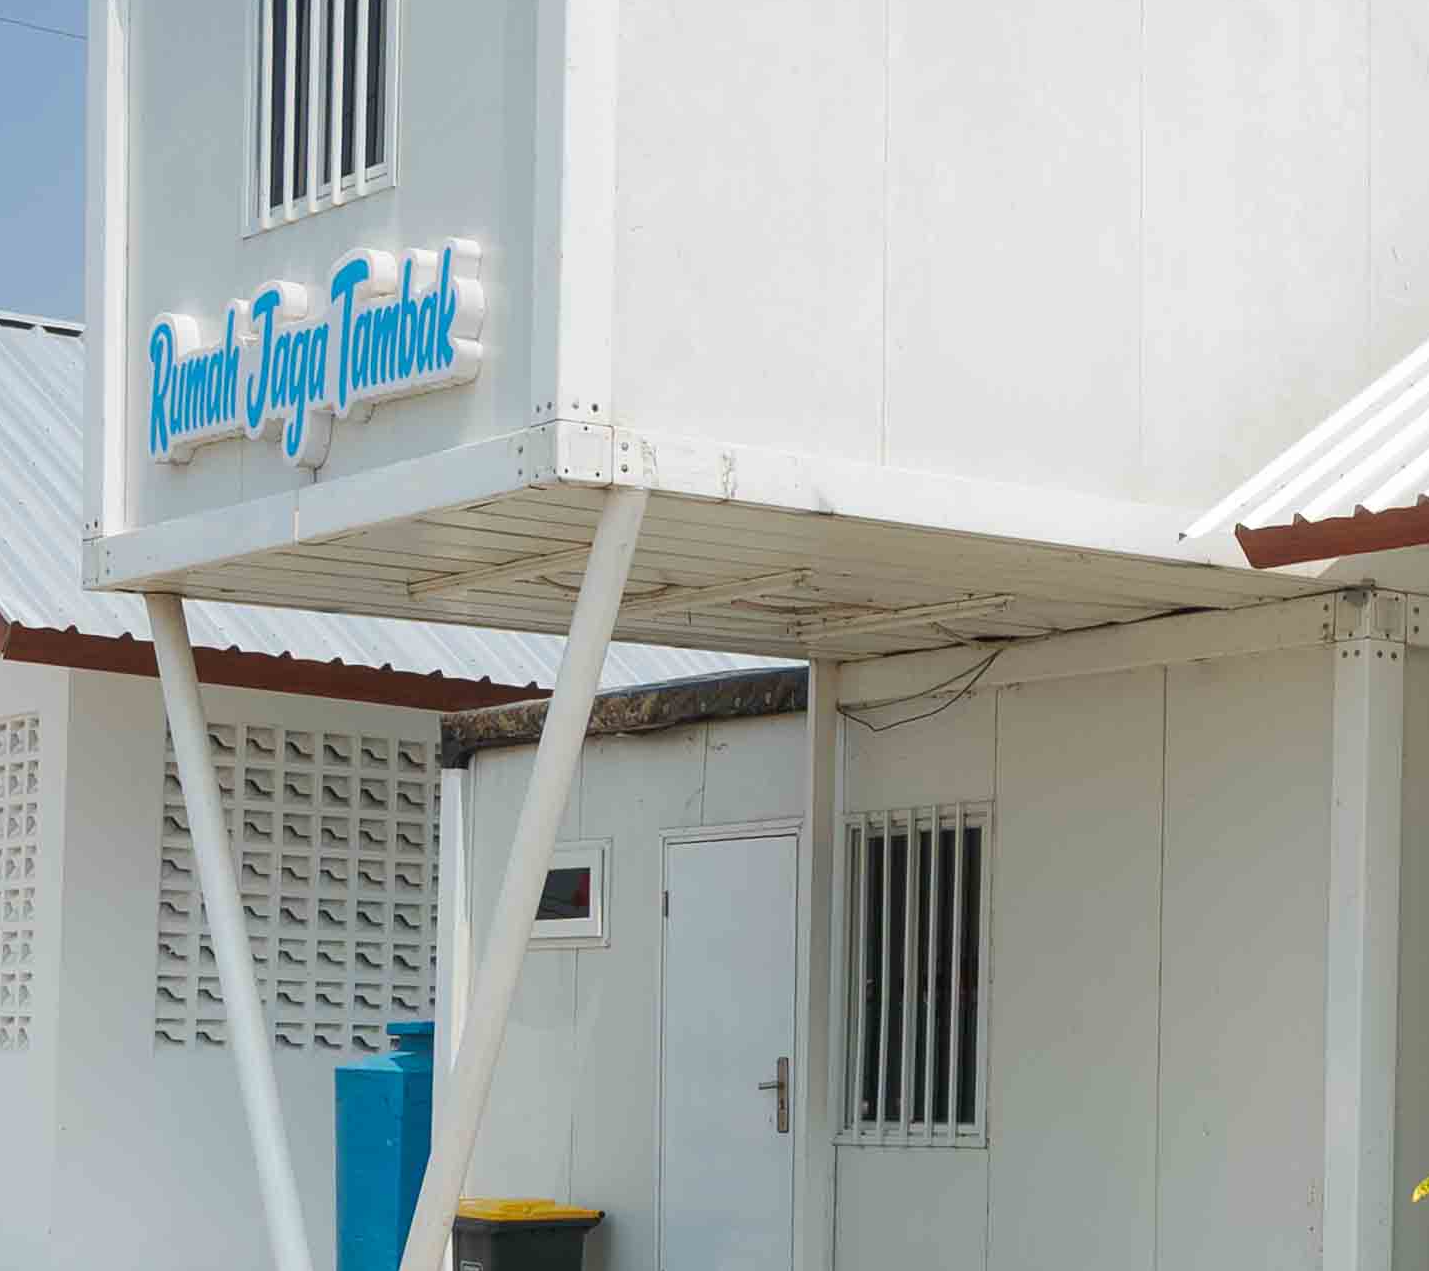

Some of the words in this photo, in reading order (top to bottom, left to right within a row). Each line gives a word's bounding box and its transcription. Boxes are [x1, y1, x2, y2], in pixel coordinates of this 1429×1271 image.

[148, 309, 240, 456] Rumah
[246, 289, 330, 458] Jaga
[330, 245, 457, 408] Tambak
